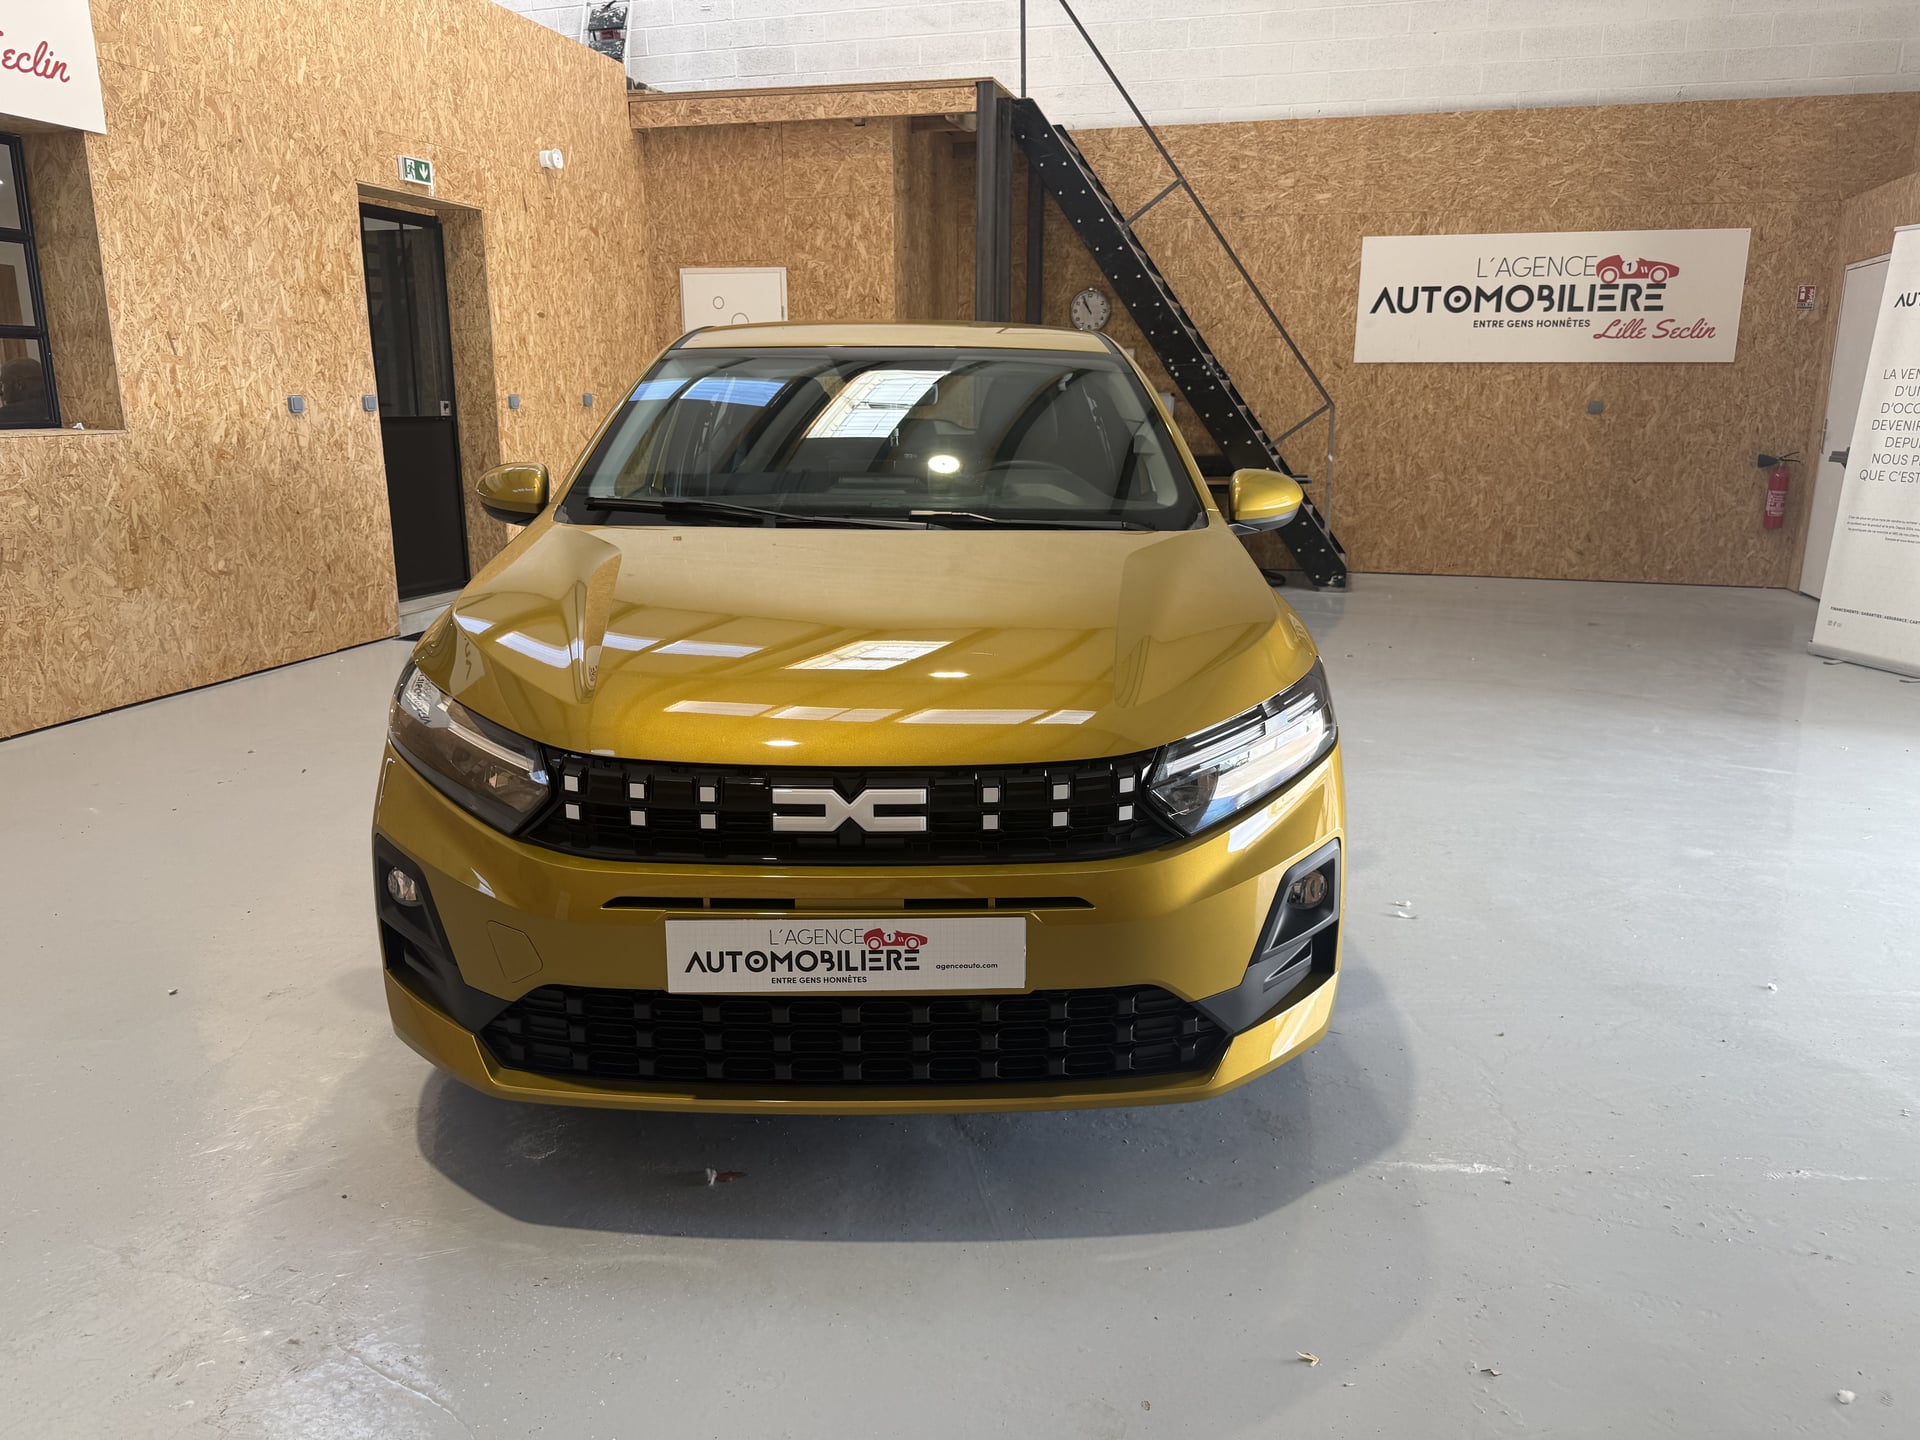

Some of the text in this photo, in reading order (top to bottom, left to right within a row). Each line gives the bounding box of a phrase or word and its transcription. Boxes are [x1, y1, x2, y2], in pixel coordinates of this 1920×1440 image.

[0, 30, 70, 82] eclin
[1476, 255, 1598, 278] L'AGENCE
[1473, 317, 1591, 328] ENTRE GENS HONNÊTES
[1592, 317, 1717, 339] Lille Seclin
[1883, 368, 1897, 380] LA
[1871, 453, 1909, 466] NOUS
[1859, 469, 1886, 481] QUE
[769, 928, 865, 946] L'AGENCE
[935, 962, 998, 971] agenceauto.com
[771, 974, 868, 985] ENTRE GENS HONNÊTES
